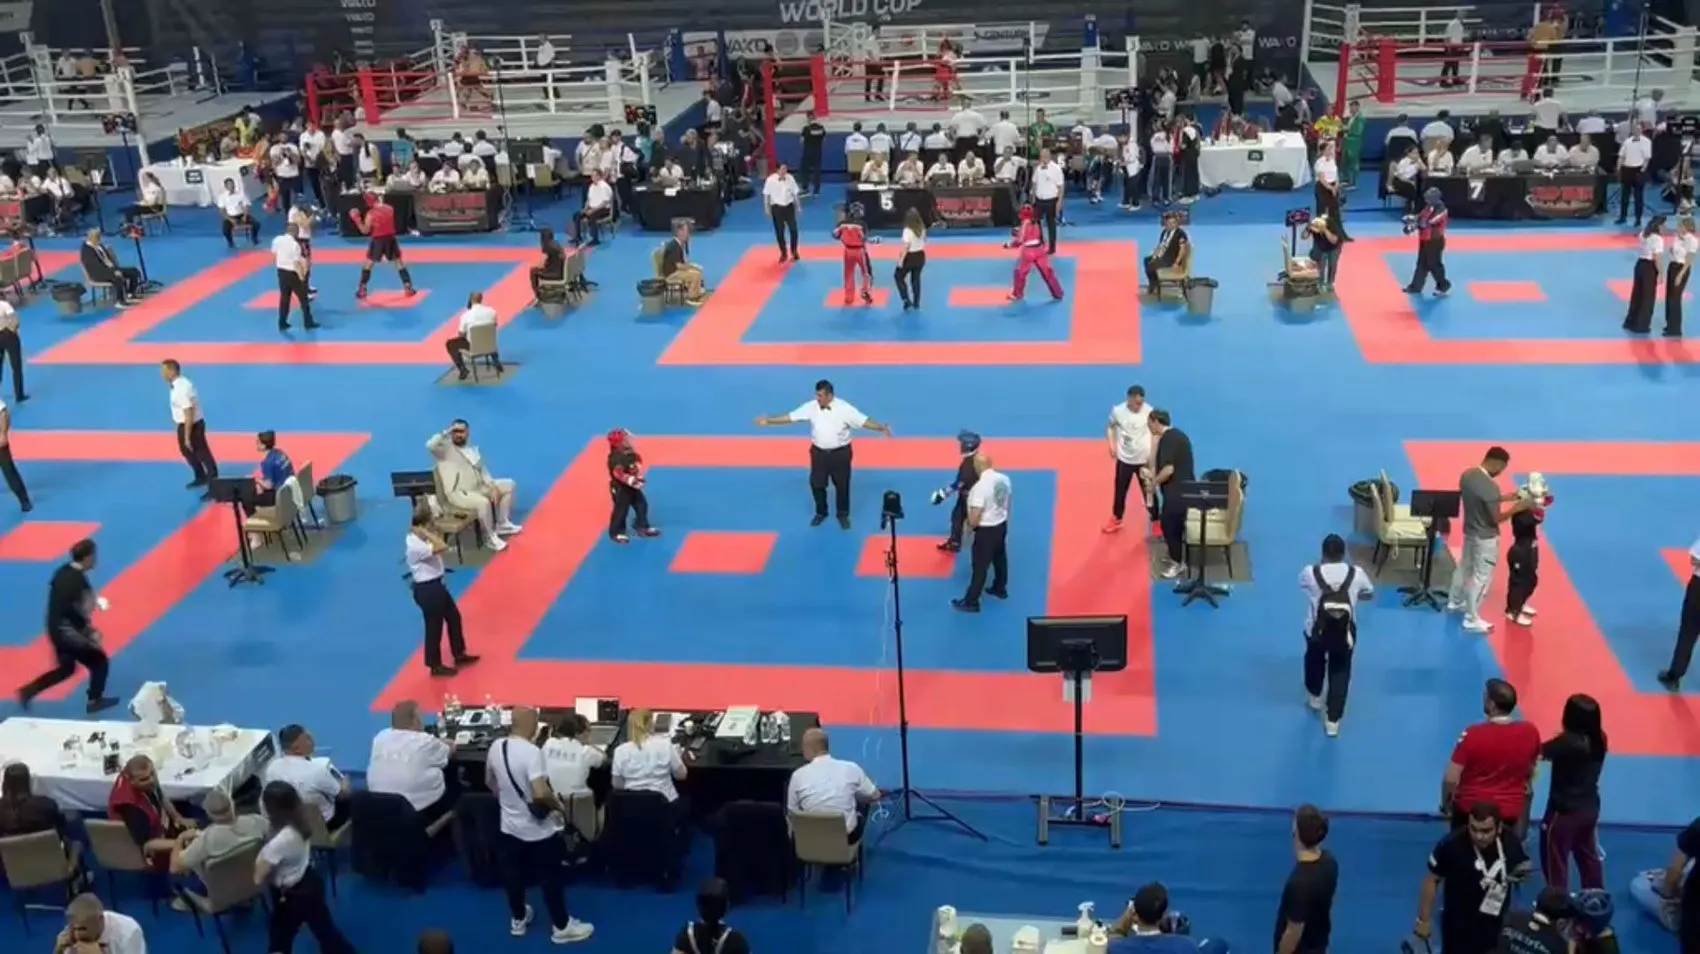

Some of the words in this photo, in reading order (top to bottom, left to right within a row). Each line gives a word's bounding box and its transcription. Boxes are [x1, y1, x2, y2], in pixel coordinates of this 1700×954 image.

[779, 0, 868, 23] WORLD
[873, 0, 923, 14] CUP
[1258, 36, 1297, 48] WAO
[1469, 182, 1483, 199] 7
